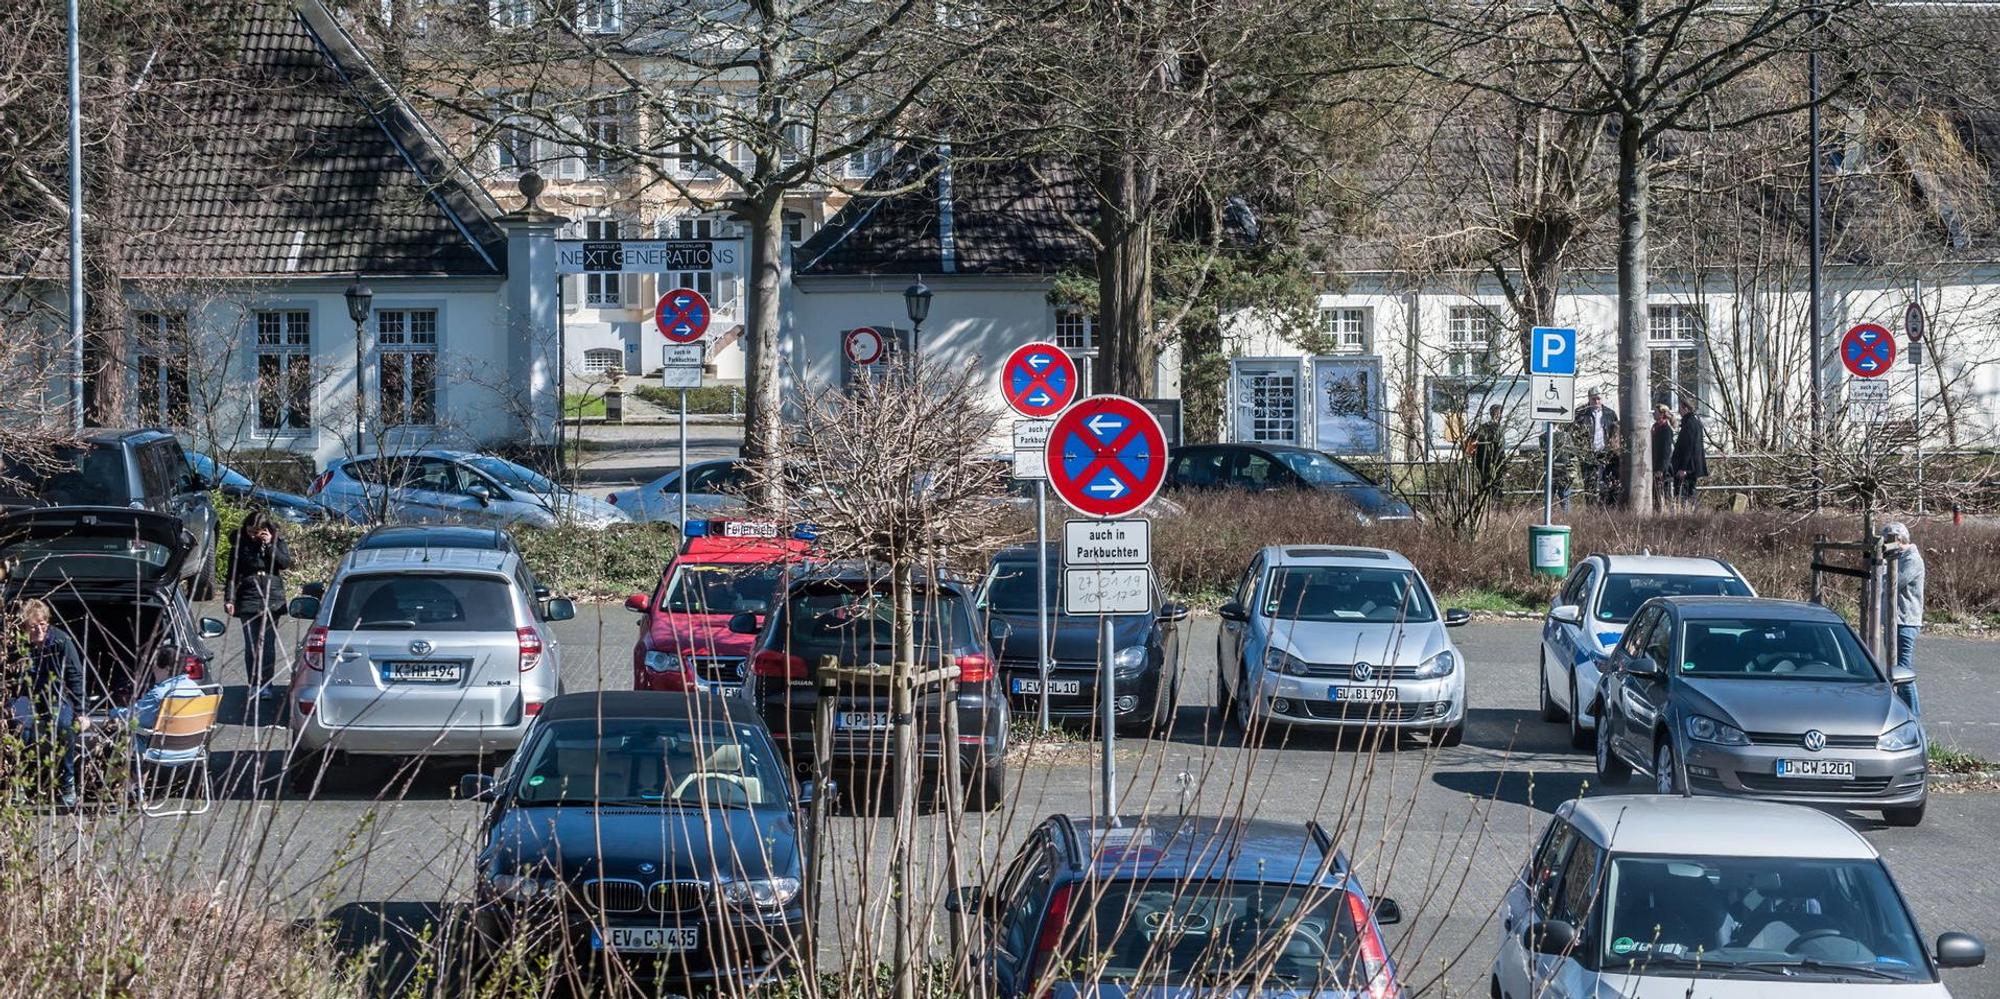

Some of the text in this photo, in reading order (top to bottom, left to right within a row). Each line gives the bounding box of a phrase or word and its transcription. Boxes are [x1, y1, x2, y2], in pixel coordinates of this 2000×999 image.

[561, 249, 733, 265] NEXT GENERATIONS
[1542, 333, 1566, 368] P
[1089, 528, 1125, 540] auch in
[1077, 546, 1139, 558] Parkbuchten
[394, 664, 454, 678] K HM 194
[1063, 683, 1077, 694] 10
[1336, 688, 1349, 699] GL
[1785, 761, 1852, 775] D CW 1201
[607, 929, 632, 947] EV
